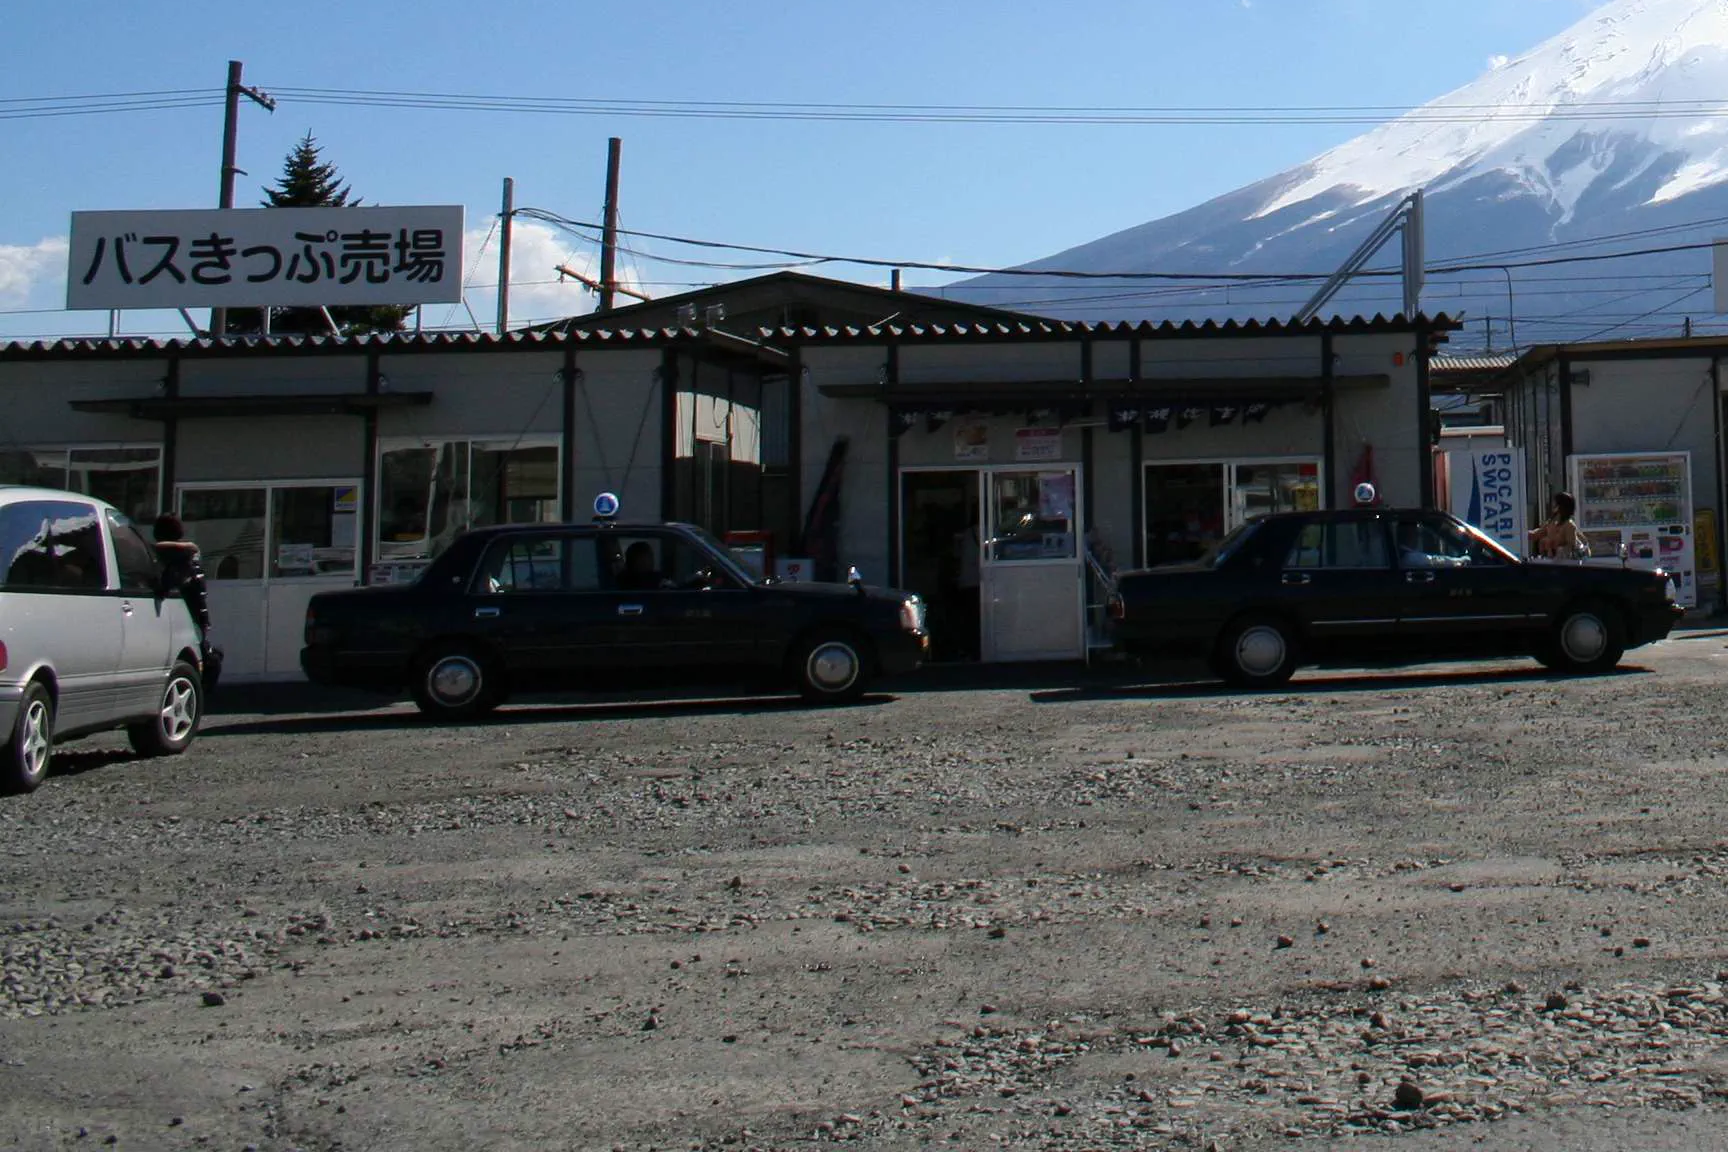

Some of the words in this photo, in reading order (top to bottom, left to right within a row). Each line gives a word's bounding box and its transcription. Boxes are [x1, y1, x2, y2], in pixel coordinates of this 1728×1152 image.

[83, 229, 445, 285] バスきっぷ売場
[1482, 454, 1498, 531] SWEAT
[1498, 453, 1513, 539] POCARI
